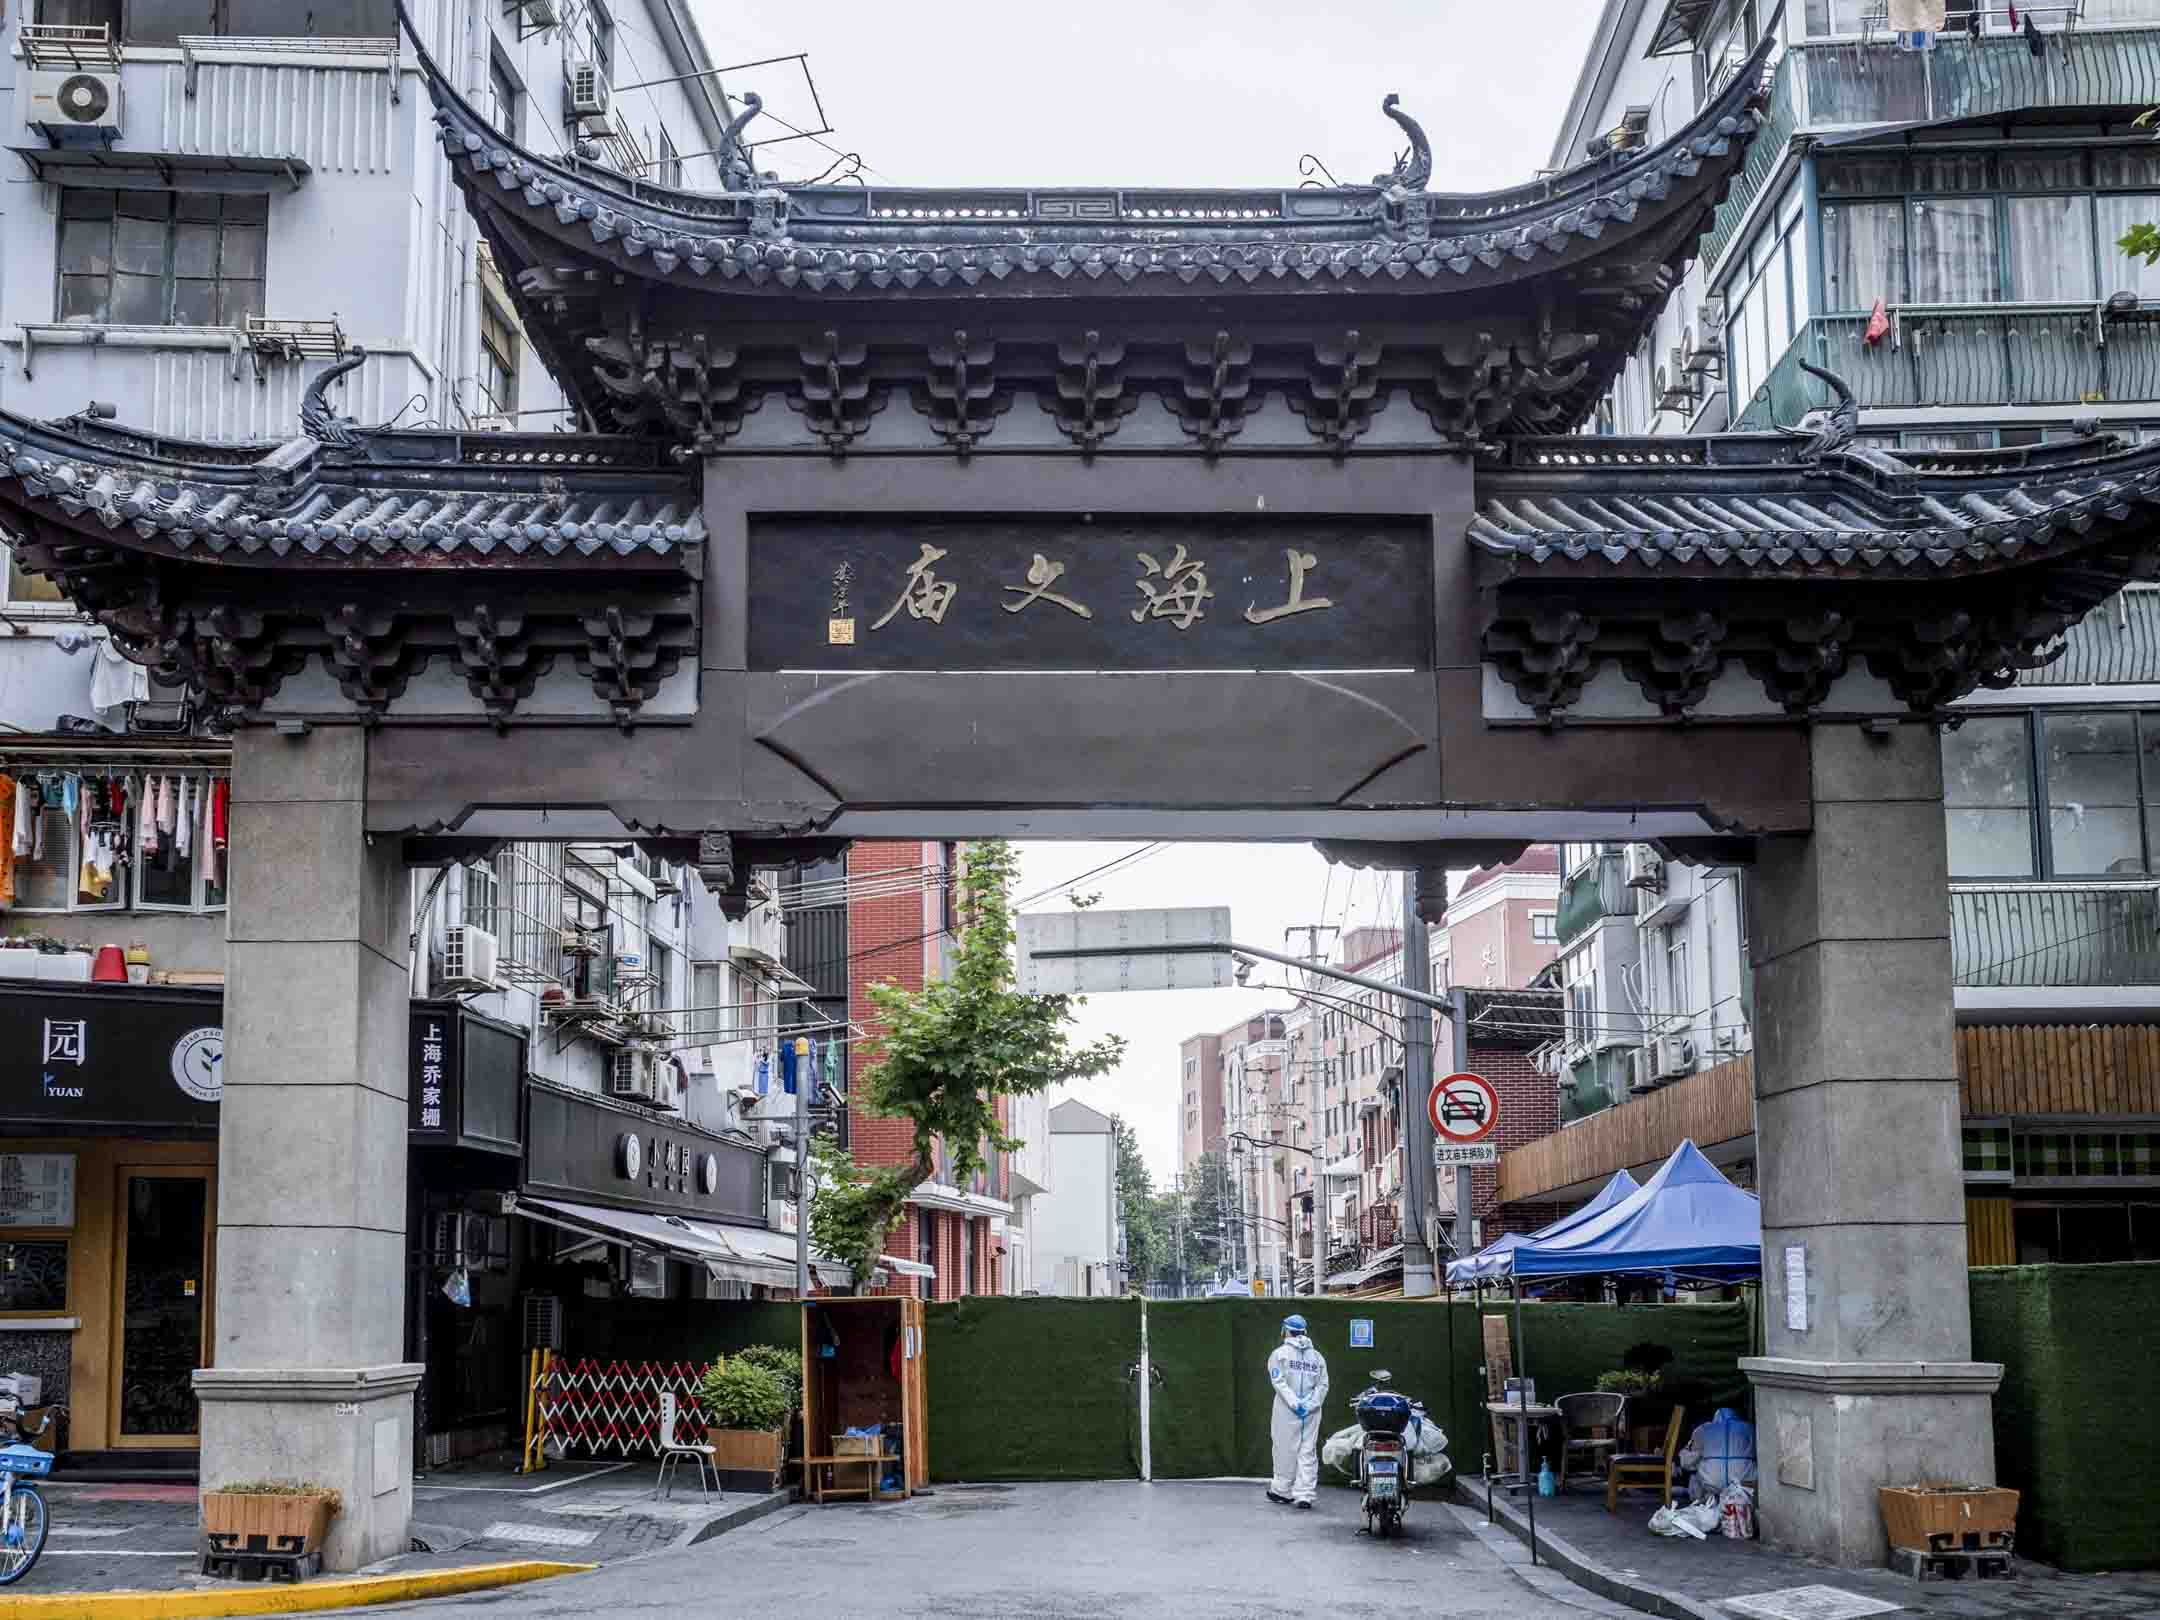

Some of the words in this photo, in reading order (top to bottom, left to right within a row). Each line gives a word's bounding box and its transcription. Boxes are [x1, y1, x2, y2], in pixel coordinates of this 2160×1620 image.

[42, 1016, 87, 1067] 园
[422, 1023, 442, 1127] 上海乔家栅
[48, 1087, 84, 1097] YUAN
[1436, 1146, 1493, 1160] 进文庙车辆除外
